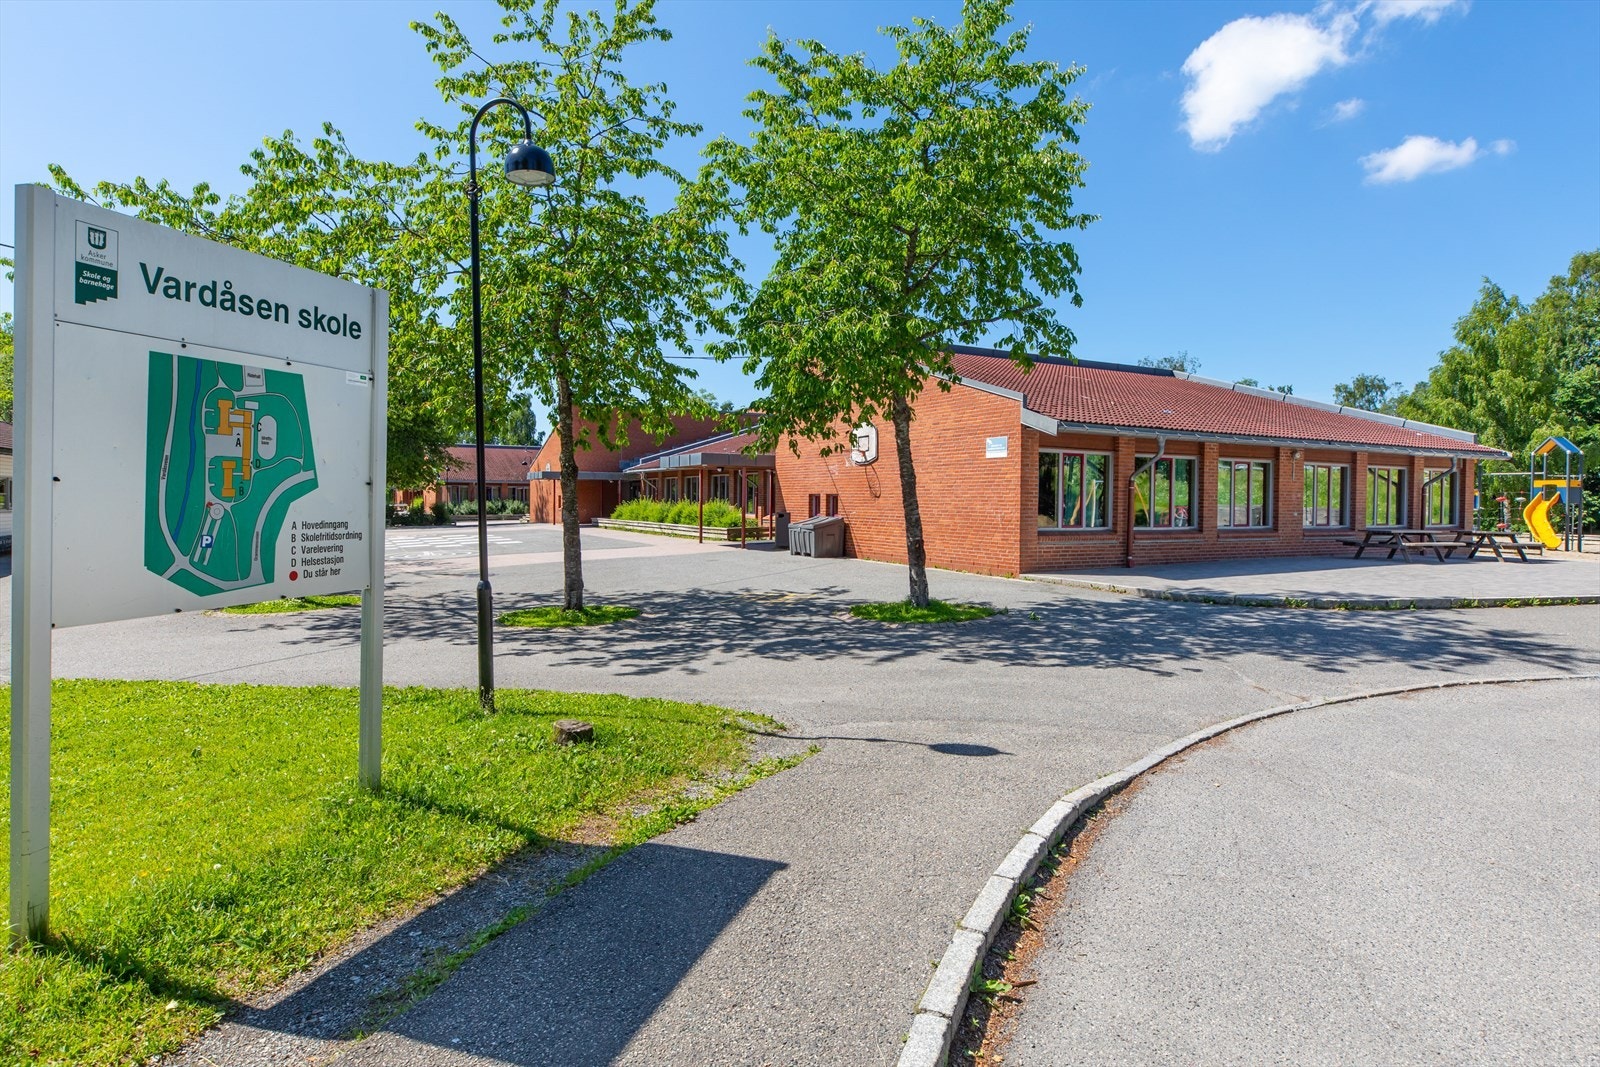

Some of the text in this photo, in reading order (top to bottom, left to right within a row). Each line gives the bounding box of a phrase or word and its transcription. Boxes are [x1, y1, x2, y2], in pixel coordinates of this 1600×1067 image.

[80, 253, 114, 268] kommune
[88, 250, 106, 260] Asker
[82, 270, 111, 283] Skole og
[139, 261, 362, 340] Vardåsen skole
[256, 422, 262, 432] C
[235, 437, 242, 447] A
[255, 459, 261, 468] D
[239, 486, 244, 496] B
[291, 520, 349, 530] A Hovedinngang
[202, 535, 212, 547] P
[291, 531, 363, 542] B Skolefritidsordning
[291, 543, 344, 555] C Varelevering
[291, 555, 344, 567] D Helsestasjon
[303, 567, 341, 579] Du står her
